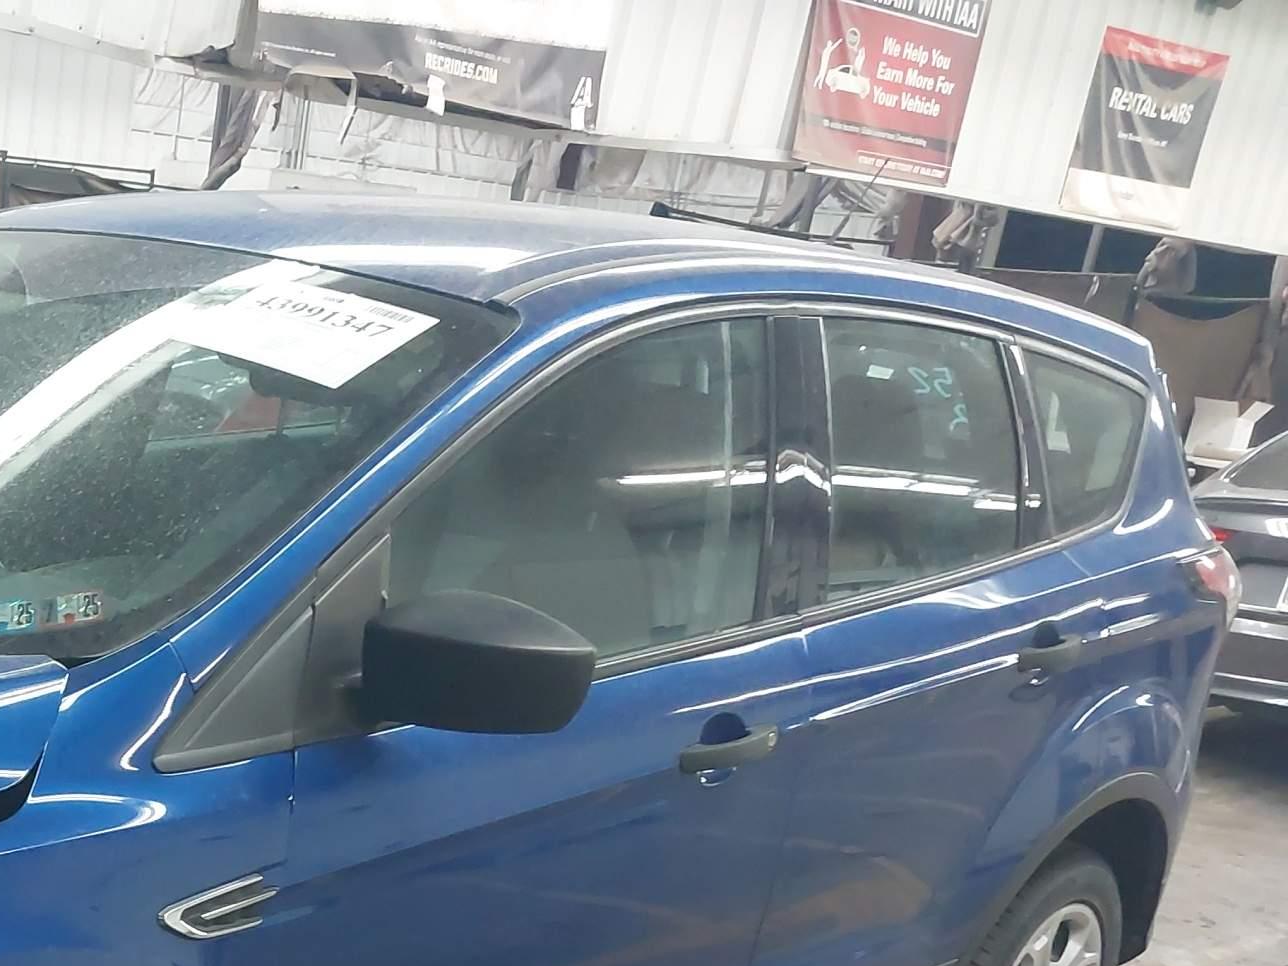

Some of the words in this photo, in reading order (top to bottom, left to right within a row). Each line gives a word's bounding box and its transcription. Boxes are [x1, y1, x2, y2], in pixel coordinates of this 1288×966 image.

[917, 0, 954, 22] WITH
[953, 0, 979, 30] IAA
[882, 36, 901, 57] We
[902, 41, 929, 67] Help
[931, 48, 951, 69] You
[876, 61, 904, 84] Earn
[905, 67, 934, 91] More
[935, 75, 955, 95] For
[872, 85, 899, 108] Your
[901, 92, 941, 117] Vehicle
[1109, 86, 1158, 118] RENTAL
[1160, 103, 1195, 125] CARS
[255, 296, 395, 337] 43991347
[16, 602, 34, 626] 25
[83, 593, 100, 617] 25
